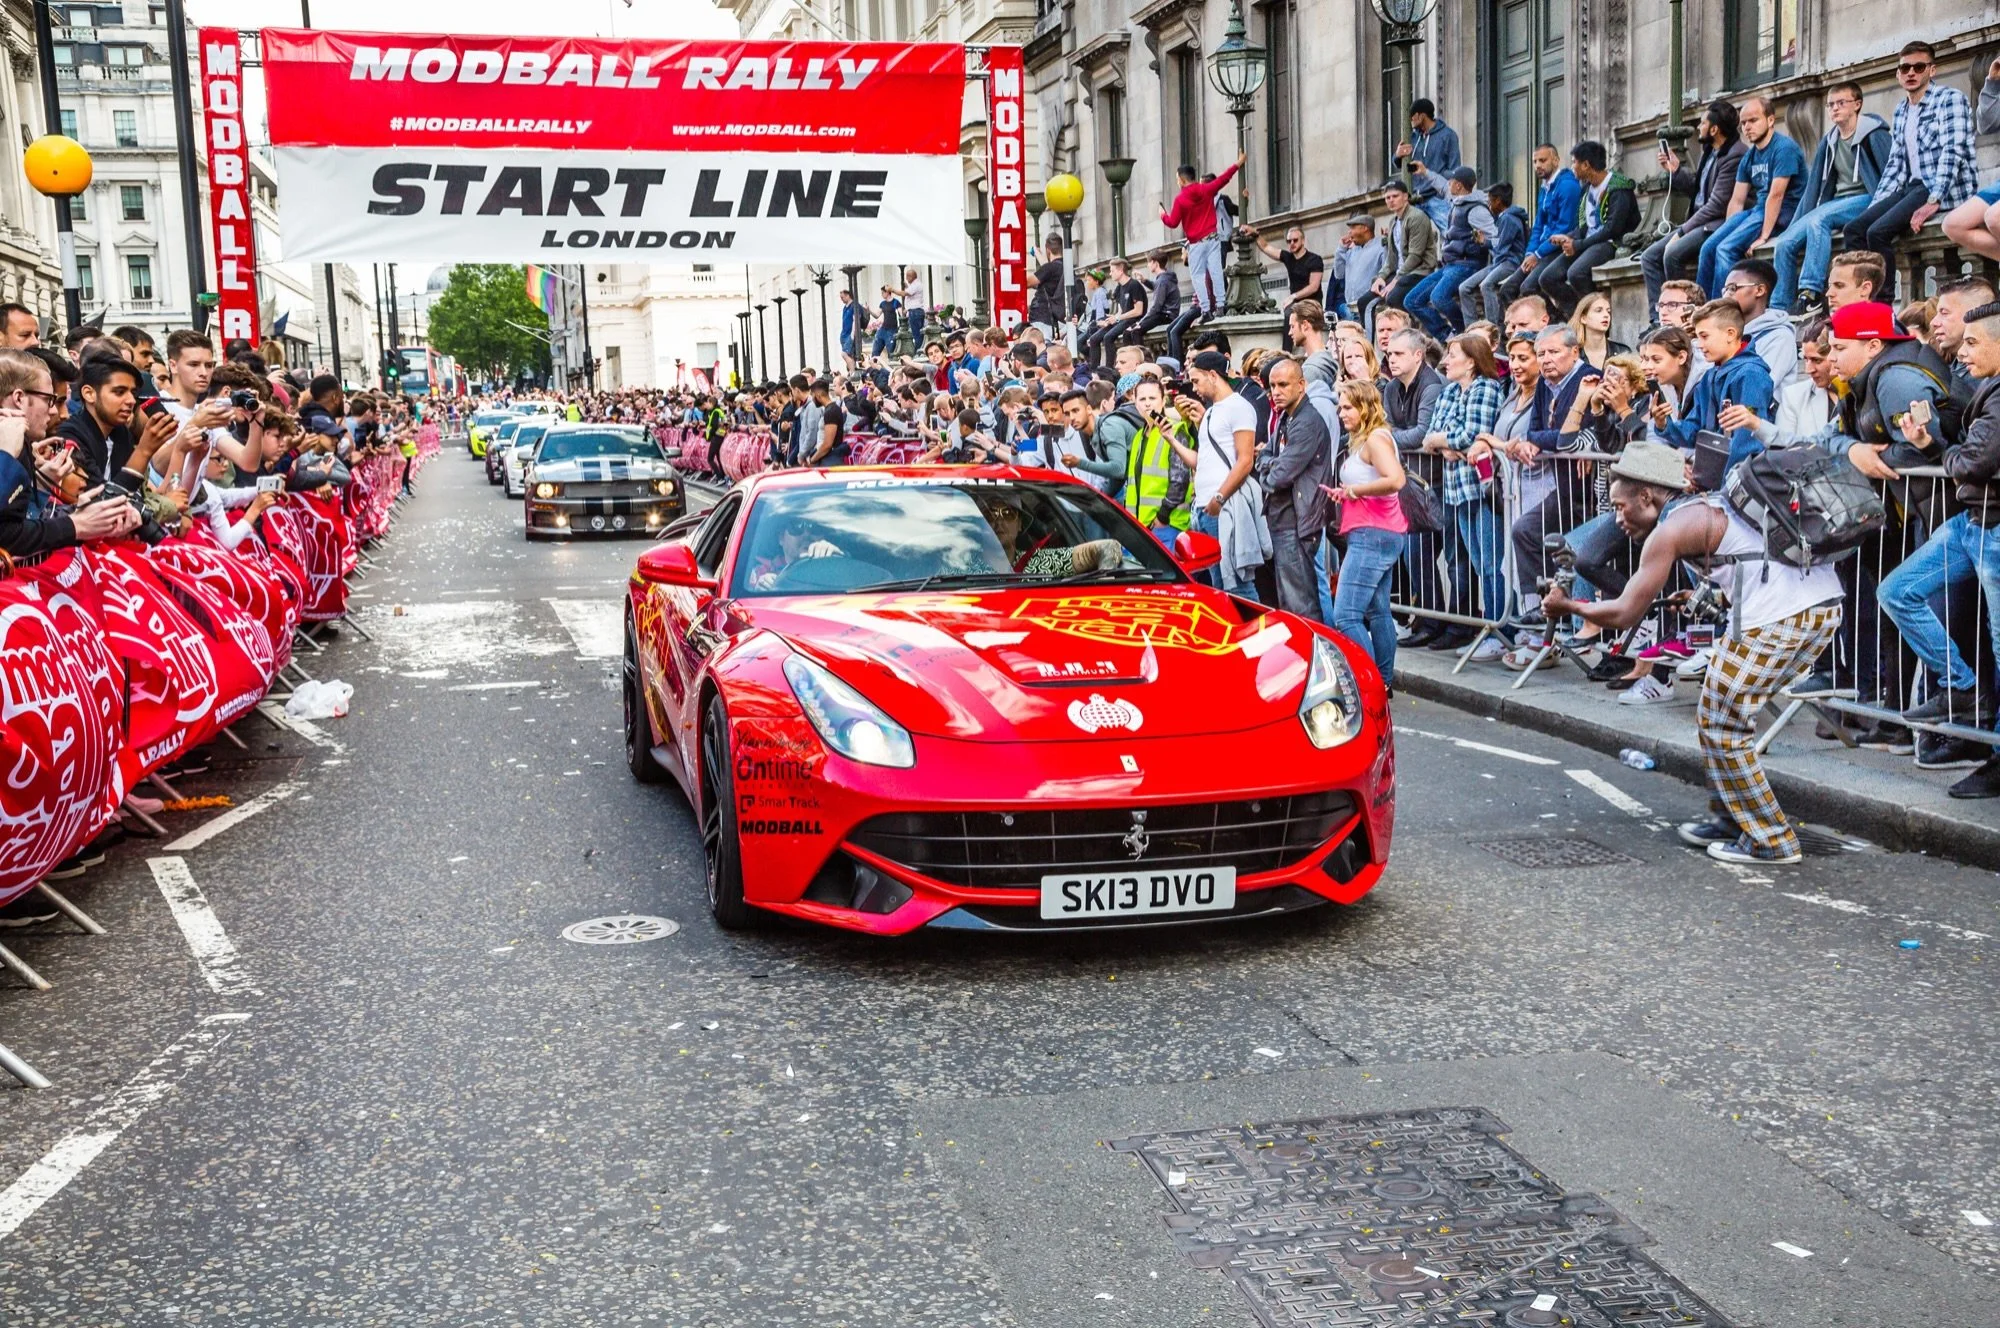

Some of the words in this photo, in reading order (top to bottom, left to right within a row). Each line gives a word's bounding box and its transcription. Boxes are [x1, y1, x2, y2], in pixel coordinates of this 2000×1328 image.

[350, 47, 662, 89] MODBALL
[682, 56, 880, 91] RALLY
[390, 117, 592, 134] #MODBALLRALLY
[206, 43, 248, 290] MODBALL
[994, 68, 1022, 292] MODBALL
[367, 162, 666, 218] START
[689, 169, 888, 219] LINE
[541, 229, 736, 249] LONDON
[846, 477, 1013, 489] MODBALL
[736, 755, 813, 781] Ontime
[740, 820, 824, 834] MODBALL
[1062, 877, 1139, 912] SK13
[1150, 873, 1214, 908] DVO
